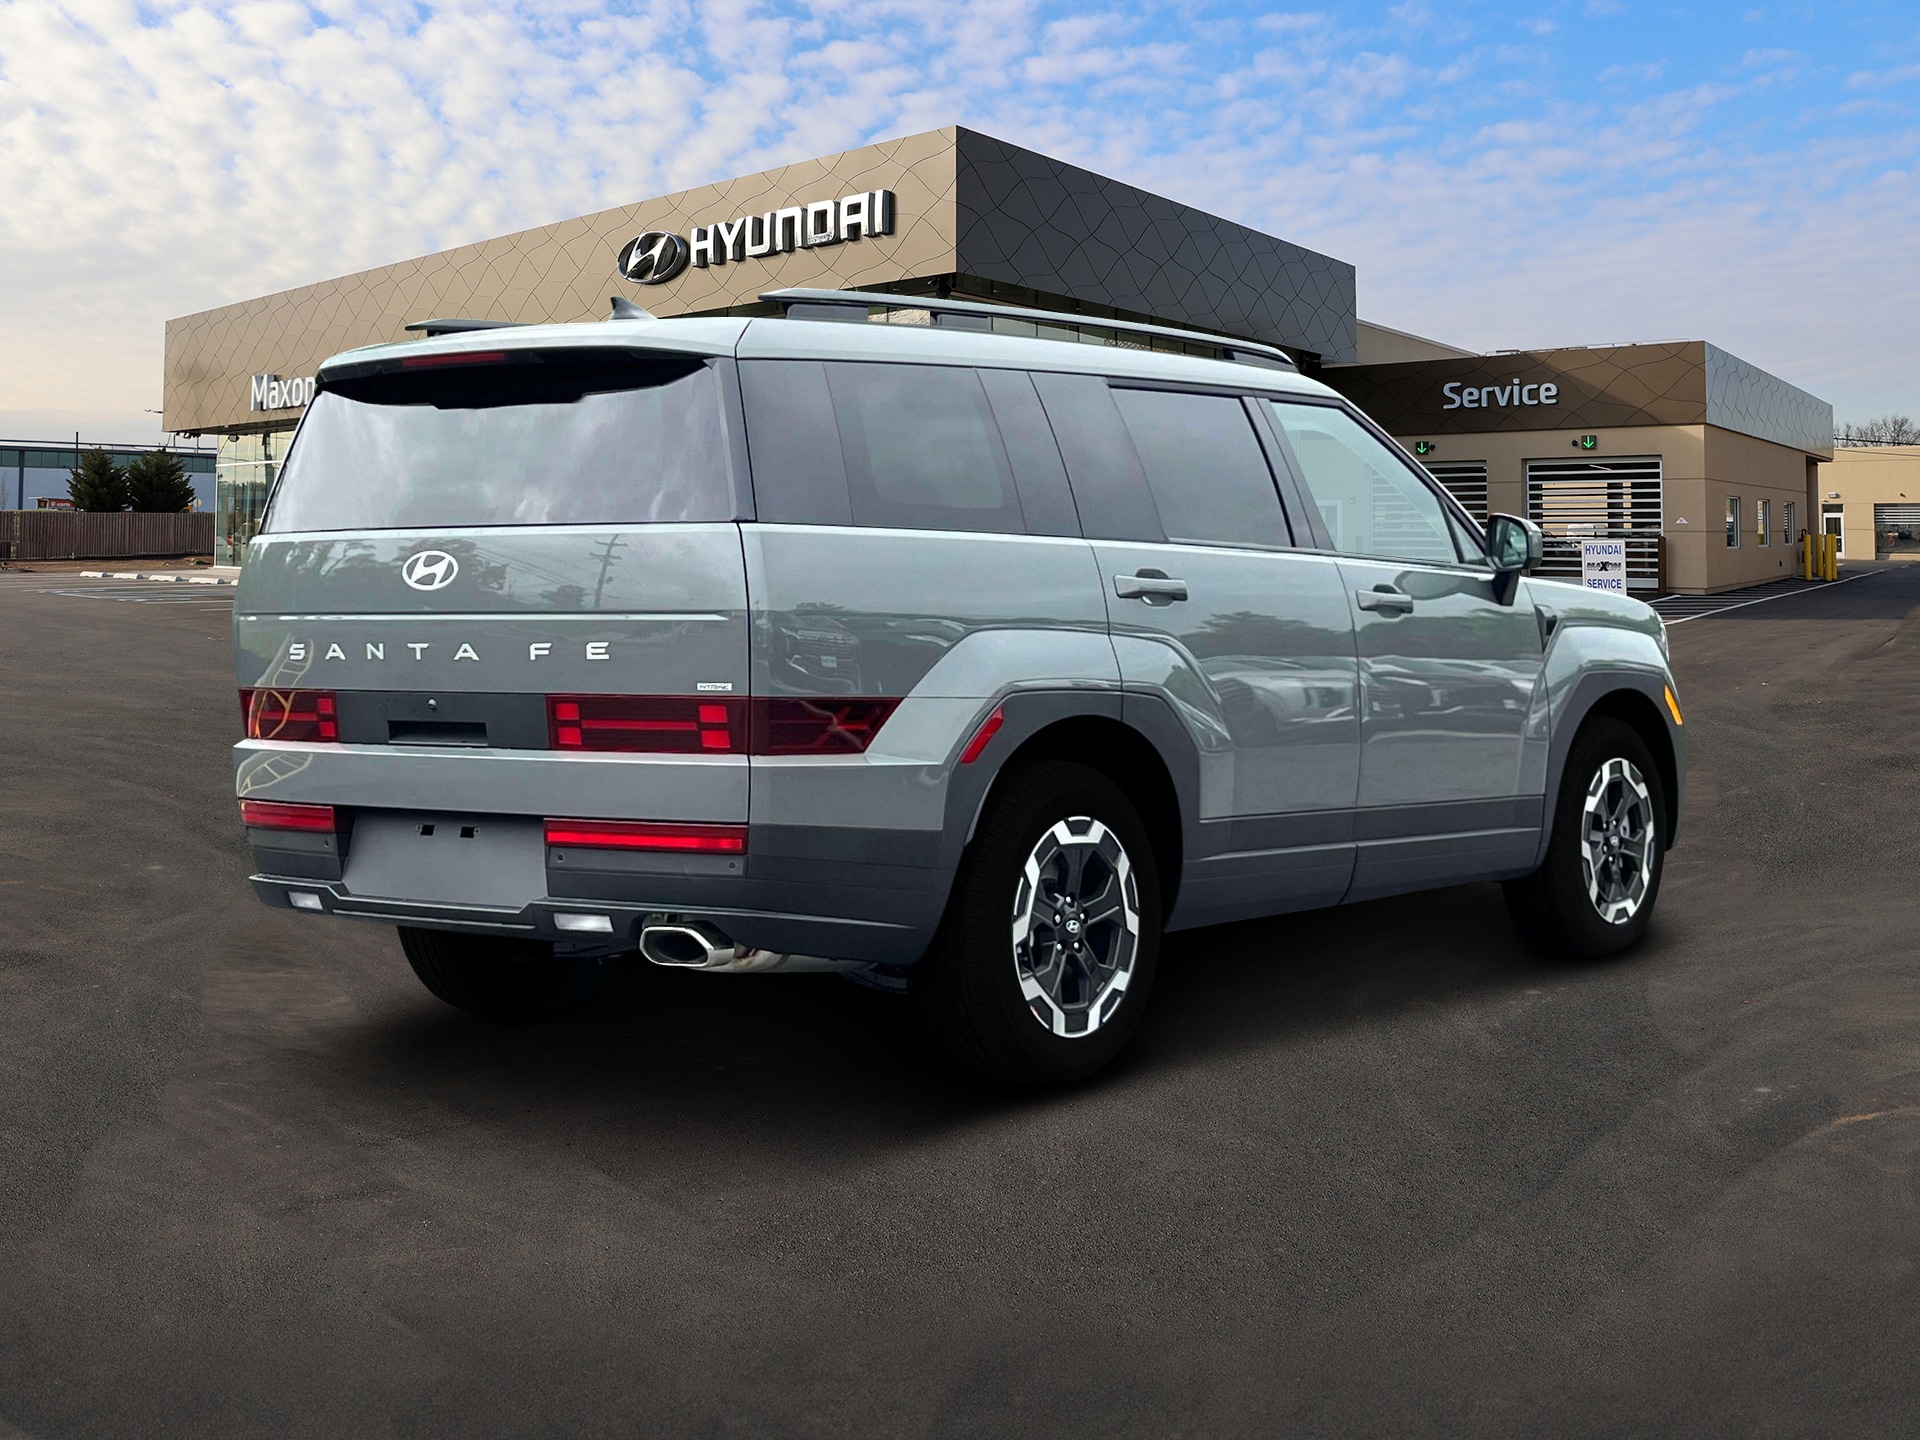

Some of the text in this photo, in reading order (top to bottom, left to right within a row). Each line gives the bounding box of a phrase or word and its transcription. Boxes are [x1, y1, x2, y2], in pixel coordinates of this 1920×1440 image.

[690, 189, 896, 268] HYUNDAI
[1442, 378, 1558, 409] Service
[1585, 544, 1622, 555] HYUNDAI
[1586, 561, 1622, 572] MAXON
[1587, 578, 1622, 589] SERVICE
[289, 641, 611, 661] SANTA FE
